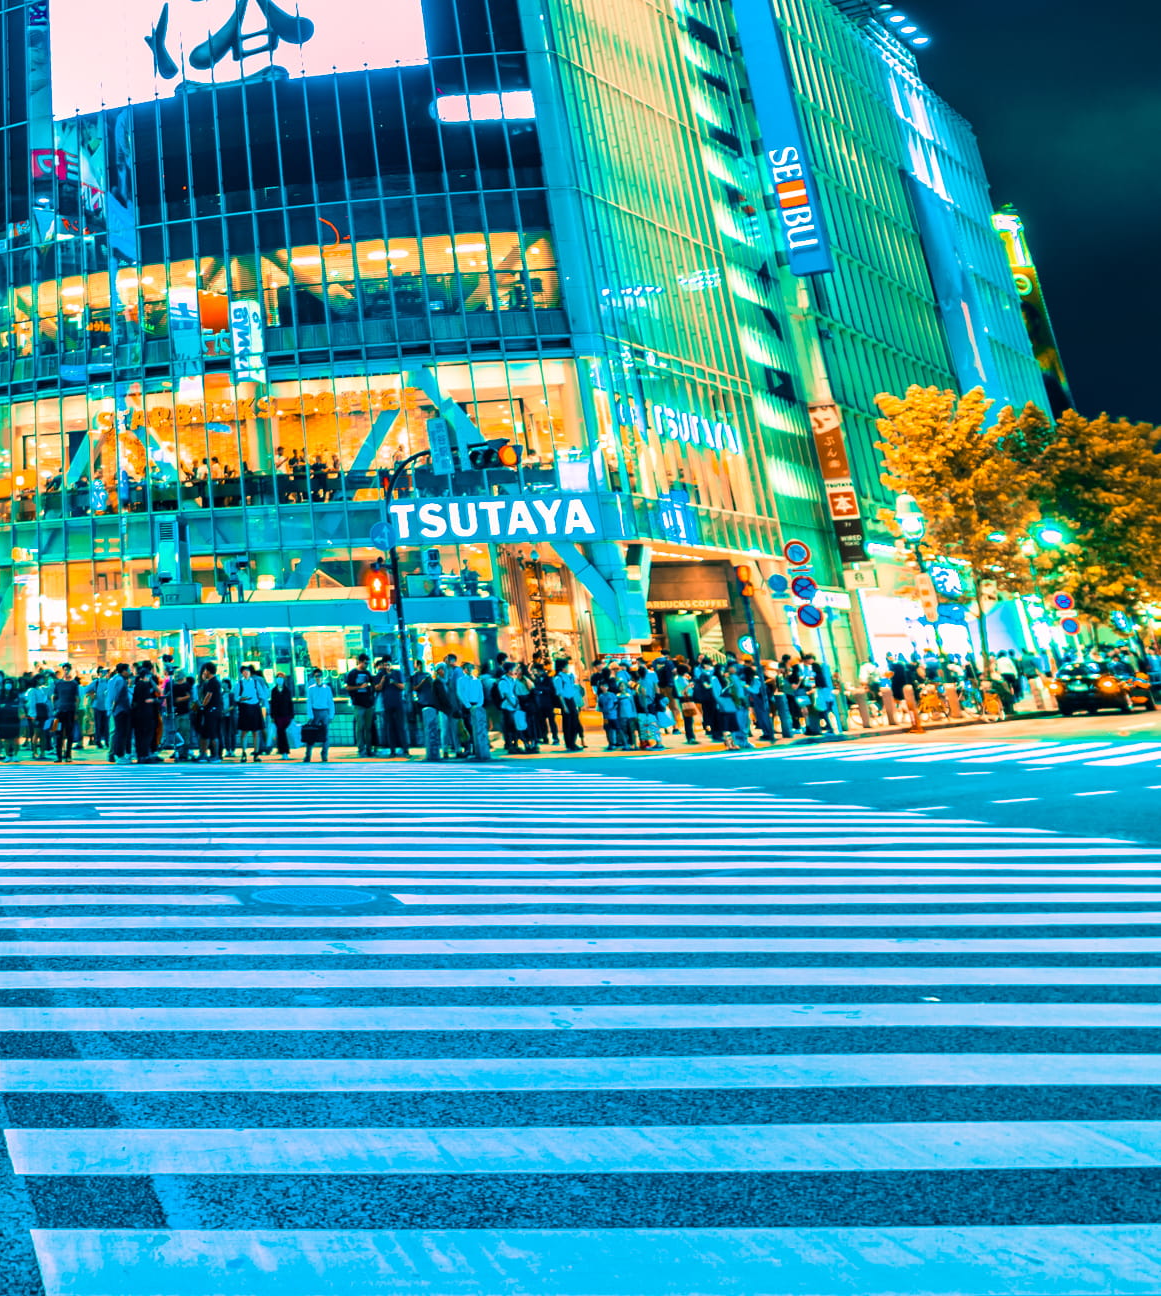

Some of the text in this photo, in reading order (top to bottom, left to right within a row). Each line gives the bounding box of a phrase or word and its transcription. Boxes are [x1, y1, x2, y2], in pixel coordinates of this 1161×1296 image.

[769, 146, 819, 250] SEIBU
[96, 396, 276, 434] SARBUCKS
[389, 499, 595, 539] TSUTAYA
[833, 495, 854, 513] 本
[646, 600, 691, 609] ARBUCKS
